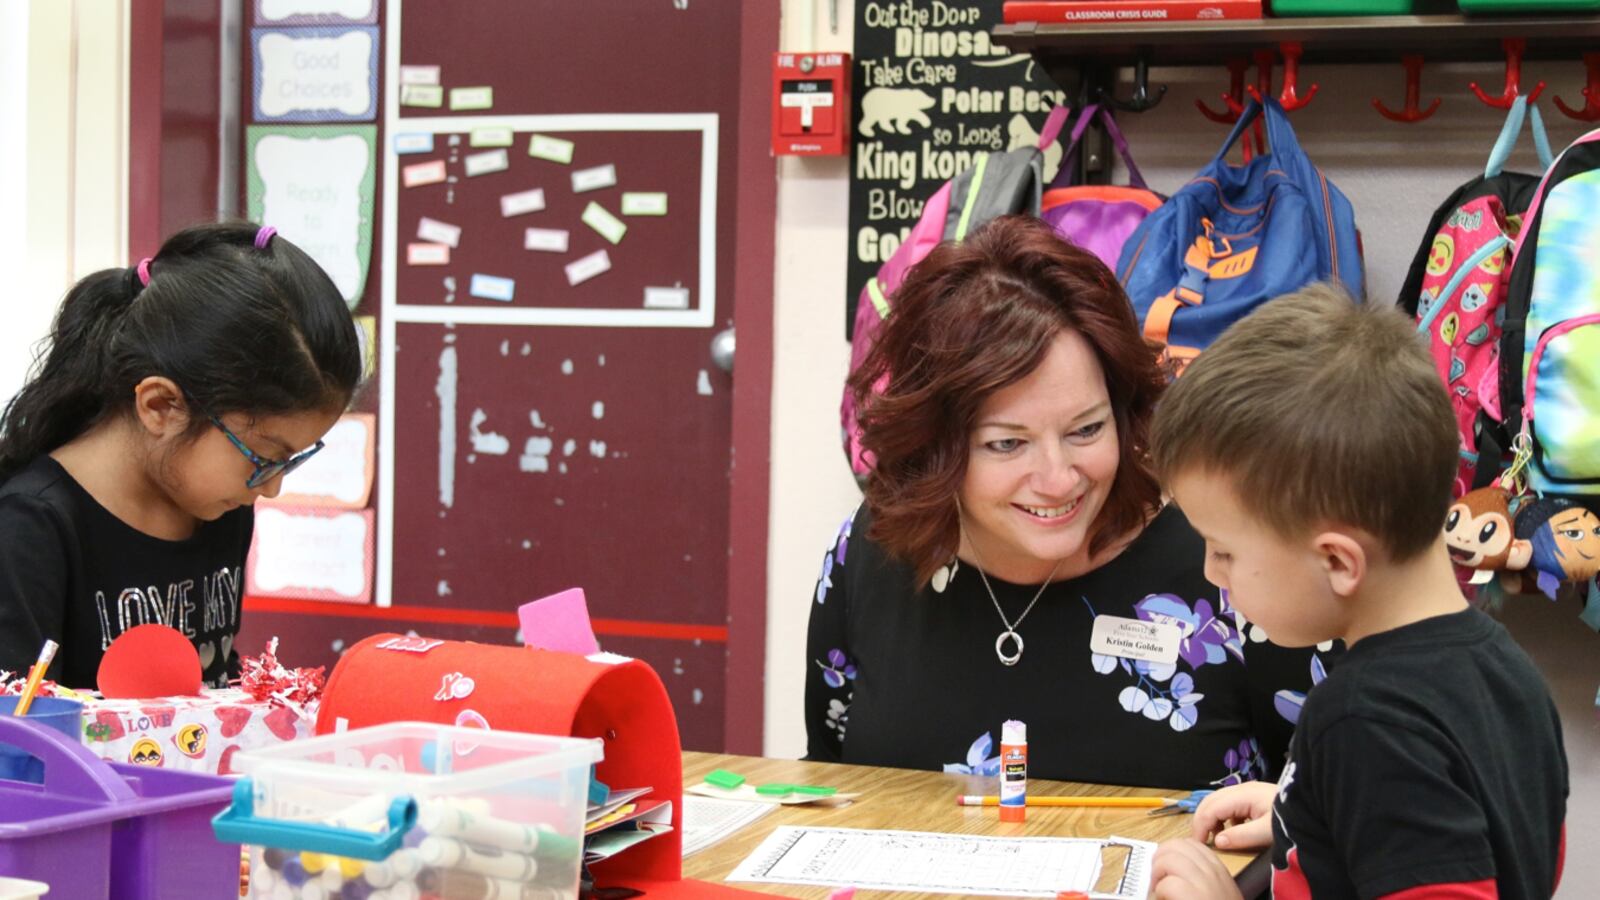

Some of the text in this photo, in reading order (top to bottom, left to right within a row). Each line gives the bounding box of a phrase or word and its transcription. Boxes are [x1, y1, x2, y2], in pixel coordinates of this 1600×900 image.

[864, 0, 981, 28] Out the Door
[1065, 9, 1167, 20] CLASSROOM CRISIS GUIDE
[293, 50, 341, 71] Good
[860, 57, 957, 86] Take Care
[279, 79, 353, 100] Choices
[941, 87, 1004, 113] Polar
[933, 123, 1003, 150] so Long
[857, 139, 980, 189] King kon
[868, 188, 924, 220] Blow
[95, 566, 240, 651] LOVE MY
[1106, 636, 1164, 653] Kristin Golden
[127, 712, 172, 732] LOVE
